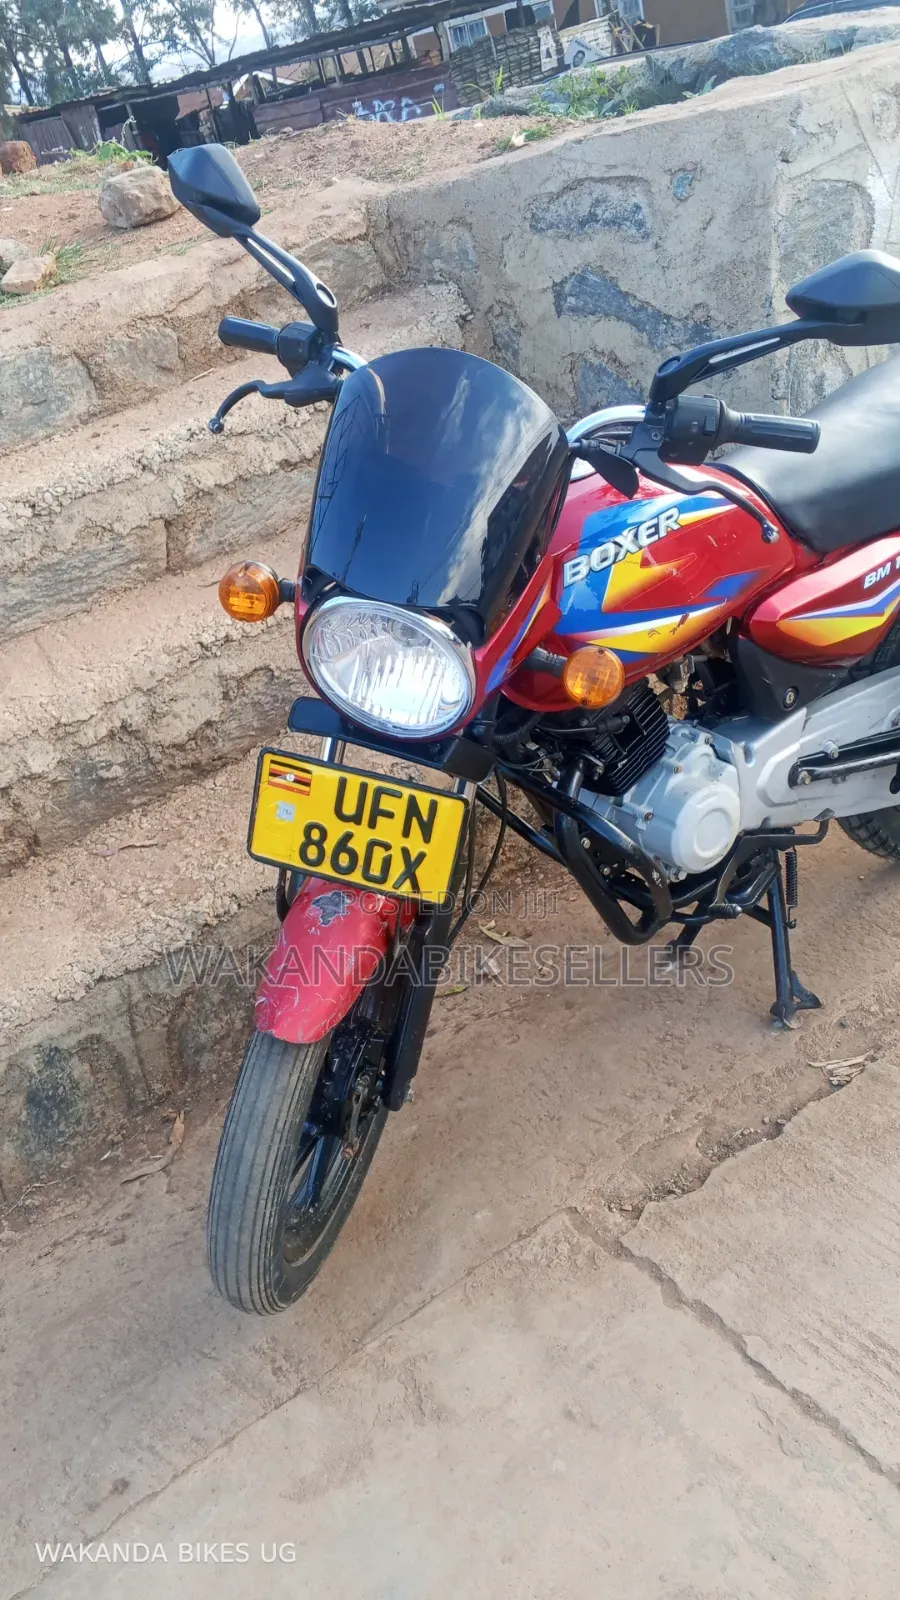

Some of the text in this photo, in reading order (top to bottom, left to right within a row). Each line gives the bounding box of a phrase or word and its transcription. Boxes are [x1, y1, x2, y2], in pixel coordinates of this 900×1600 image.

[563, 507, 682, 588] BOXER
[863, 561, 892, 590] BM
[334, 776, 438, 844] UFN
